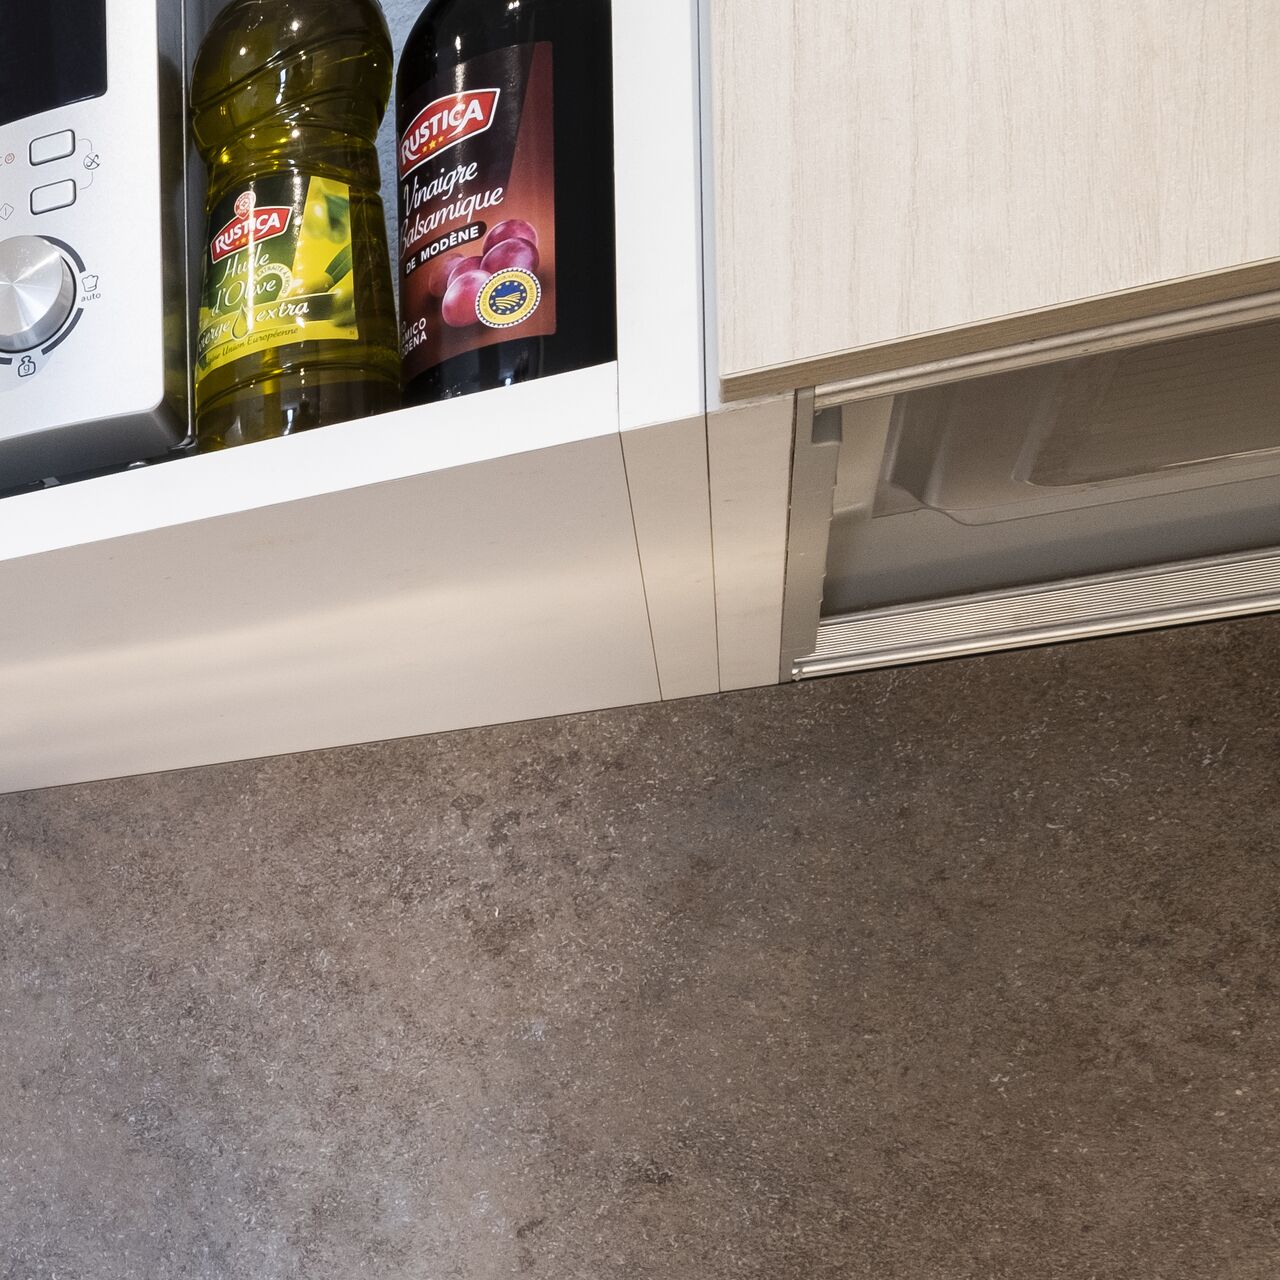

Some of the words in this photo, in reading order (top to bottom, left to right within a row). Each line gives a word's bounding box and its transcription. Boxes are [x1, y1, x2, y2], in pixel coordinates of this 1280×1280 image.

[401, 99, 484, 164] RUSTICA
[404, 162, 478, 216] Vinaigre
[215, 213, 281, 254] RUSTICA
[400, 187, 503, 258] Balsamique
[216, 243, 270, 288] Hule
[406, 258, 416, 275] DE
[420, 226, 479, 262] MODÈNE
[81, 292, 101, 303] auto
[256, 301, 310, 322] extra
[222, 341, 245, 356] Union
[247, 327, 299, 347] Européenne
